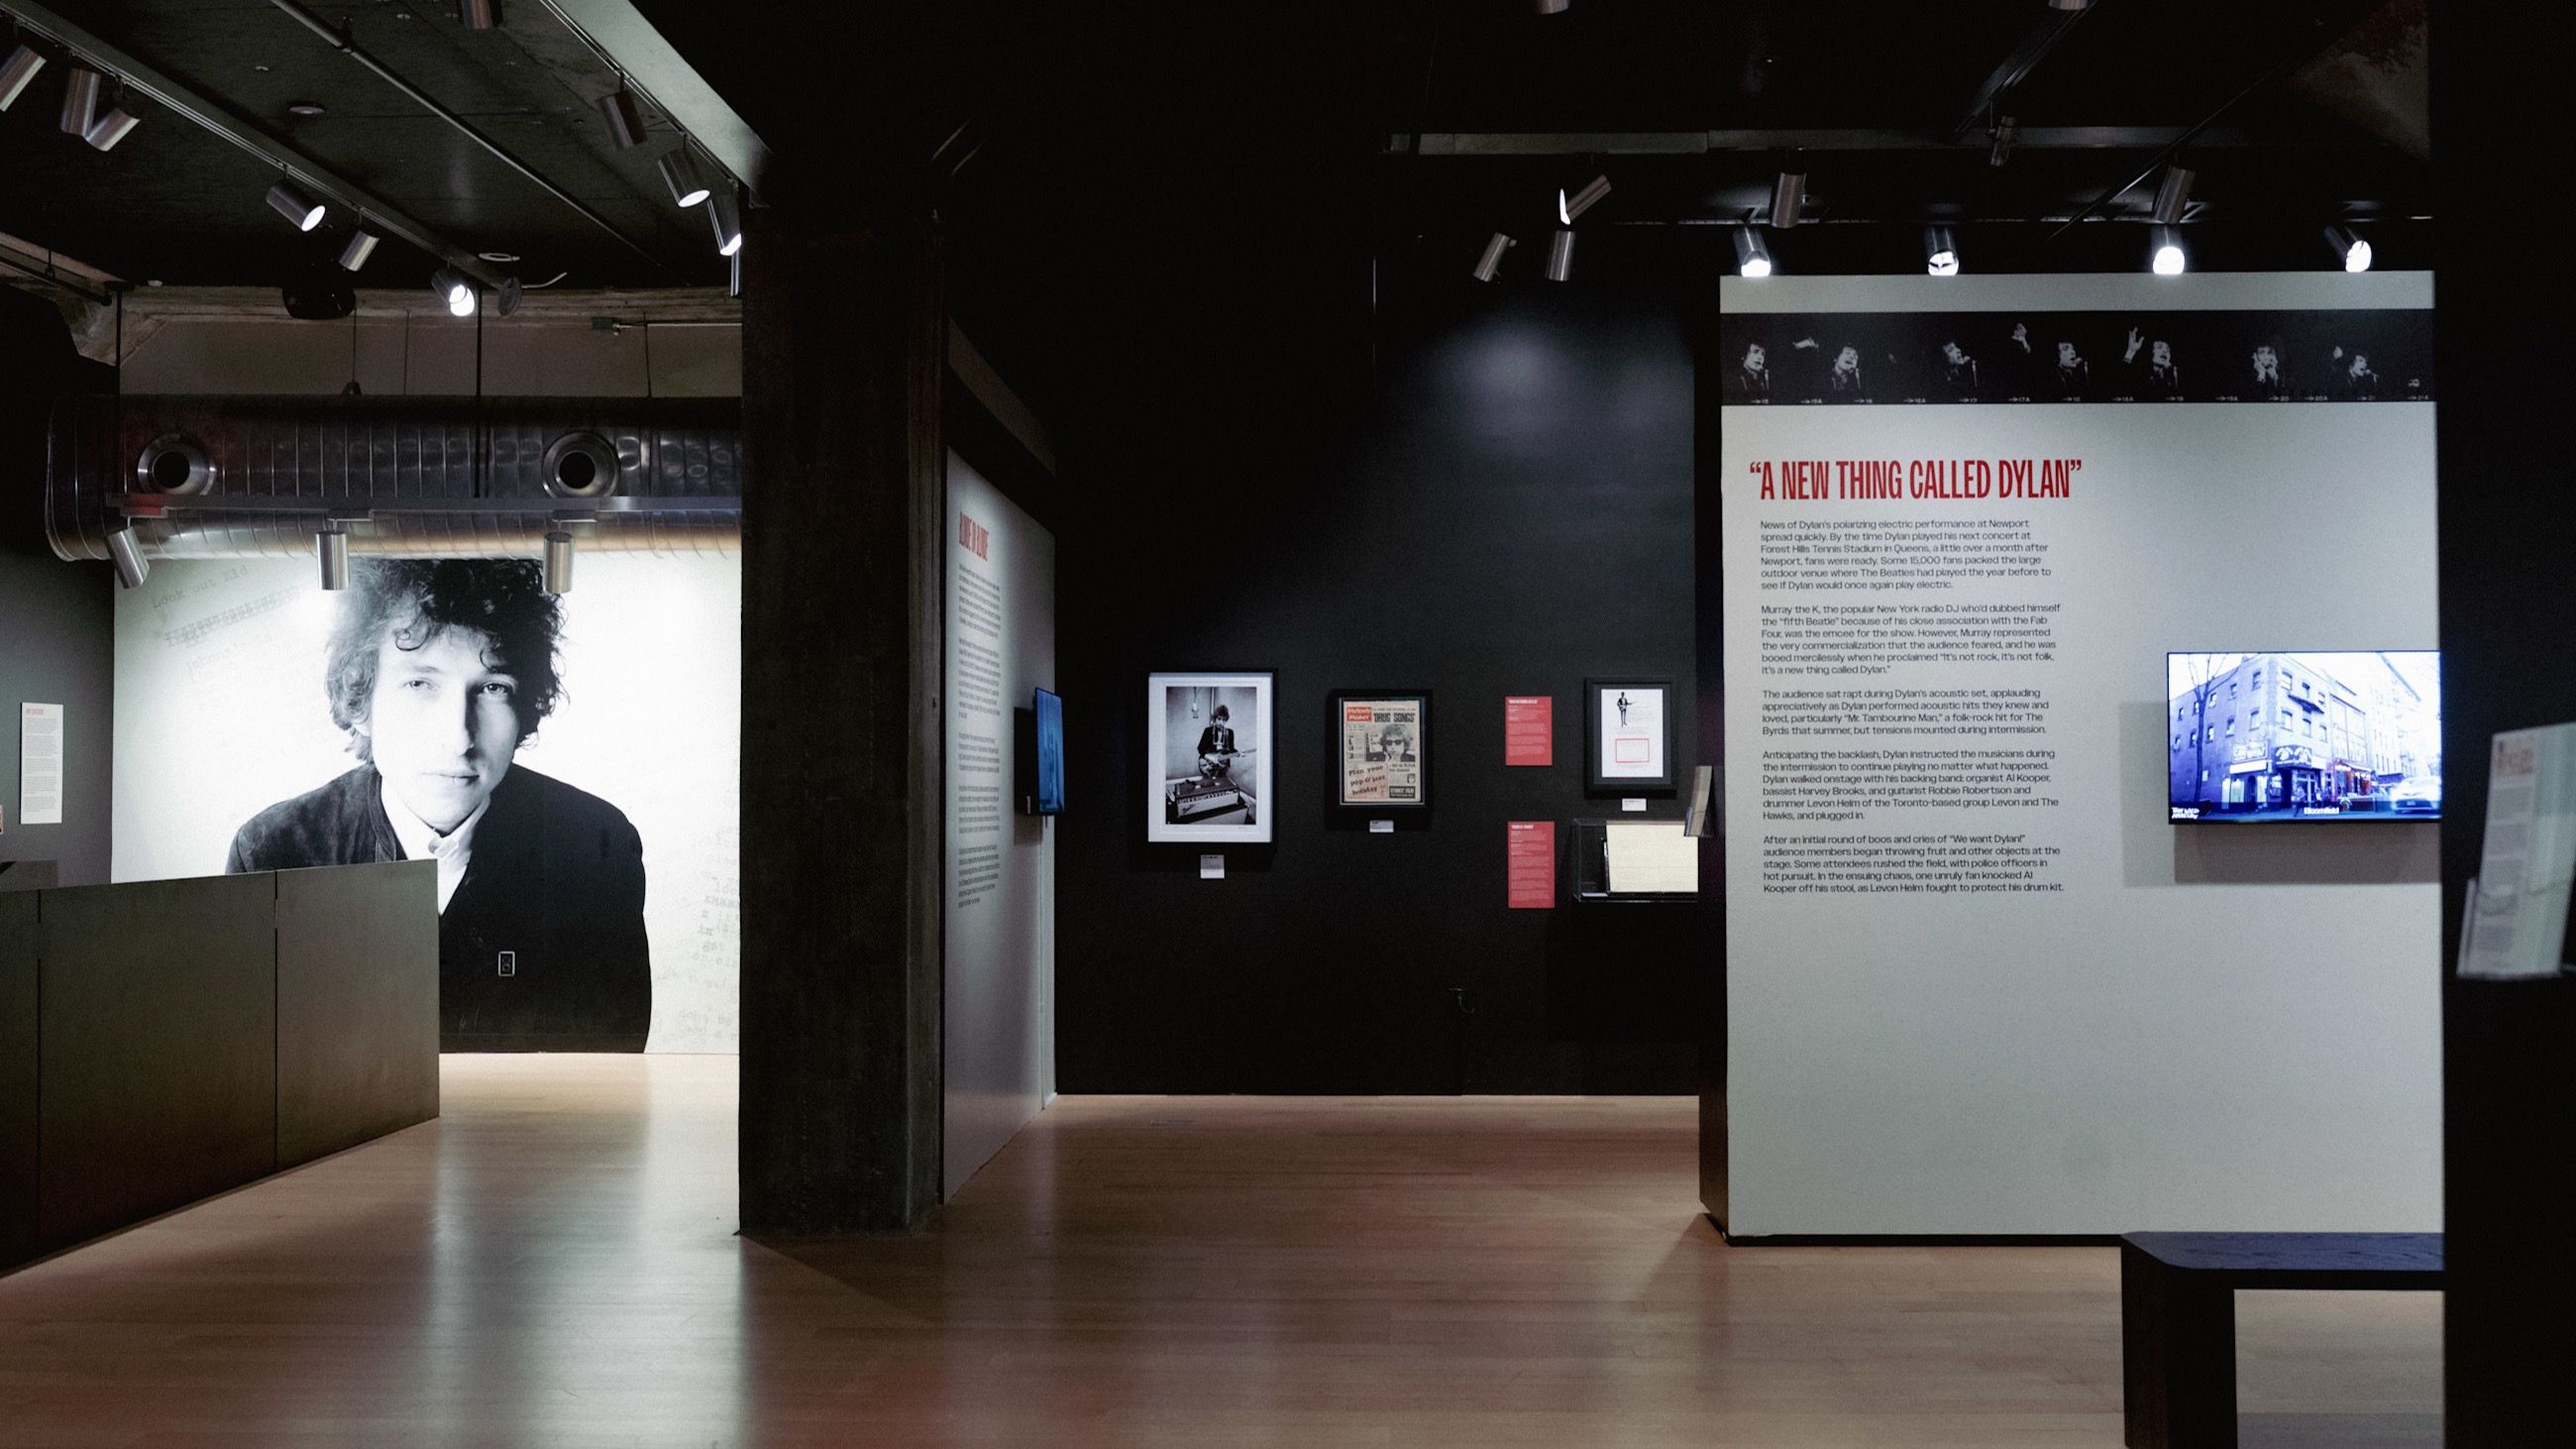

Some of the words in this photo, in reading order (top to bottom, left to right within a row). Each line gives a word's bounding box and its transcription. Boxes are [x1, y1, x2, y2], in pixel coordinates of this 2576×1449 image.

[1750, 461, 1775, 500] “A
[1782, 461, 1829, 500] NEW
[1836, 460, 1902, 500] THING
[1909, 460, 1991, 500] CALLED
[1998, 459, 2083, 499] DYLAN”
[1761, 531, 1793, 542] spread
[1829, 531, 1842, 542] By
[1844, 531, 1861, 540] the
[1862, 531, 1883, 540] time
[1884, 531, 1911, 542] Dylan
[1911, 531, 1943, 542] played
[1944, 531, 1958, 540] his
[1959, 530, 1981, 540] next
[1982, 530, 2019, 540] concert
[2020, 530, 2031, 540] at
[1761, 543, 1790, 553] Forest
[1791, 543, 1810, 553] Hills
[1812, 543, 1842, 553] Tennis
[1843, 543, 1882, 552] Stadium
[1883, 543, 1892, 552] in
[1940, 543, 1962, 552] little
[1992, 543, 2024, 552] month
[2025, 542, 2048, 552] after
[1761, 568, 1798, 577] outdoor
[1830, 567, 1859, 577] where
[1860, 567, 1878, 577] The
[1879, 567, 1915, 577] Beatles
[1916, 567, 1935, 576] had
[1935, 567, 1967, 578] played
[1968, 567, 1985, 576] the
[1986, 569, 2006, 578] year
[2007, 567, 2039, 576] before
[2041, 567, 2052, 576] to
[192, 579, 217, 594] out
[1805, 627, 1821, 637] the
[1857, 627, 1871, 637] for
[1873, 627, 1888, 637] the
[1960, 627, 1992, 638] Murray
[1992, 627, 2051, 638] represented
[1762, 640, 1778, 649] the
[1779, 642, 1800, 651] very
[1801, 639, 1886, 649] commercialization
[1887, 639, 1907, 649] that
[1909, 639, 1926, 649] the
[1927, 639, 1970, 649] audience
[2004, 639, 2023, 648] and
[2023, 639, 2036, 648] he
[1762, 701, 1827, 712] appreciatively
[1841, 701, 1868, 712] Dylan
[1868, 701, 1919, 712] performed
[1920, 701, 1961, 710] acoustic
[1962, 701, 1981, 710] hits
[1982, 700, 2004, 712] they
[2004, 700, 2030, 710] knew
[2031, 700, 2050, 710] and
[1762, 725, 1789, 736] Byrds
[1791, 725, 1811, 734] that
[1853, 724, 1871, 734] but
[1872, 724, 1912, 734] tensions
[1913, 724, 1957, 734] mounted
[1957, 724, 1987, 736] during
[1763, 749, 1819, 760] Anticipating
[1820, 749, 1837, 758] the
[1882, 749, 1909, 760] Dylan
[1909, 749, 1959, 758] instructed
[1961, 749, 1977, 758] the
[1978, 748, 2024, 758] musicians
[2025, 748, 2056, 760] during
[1367, 764, 1383, 773] your
[1763, 761, 1779, 771] the
[1779, 761, 1837, 771] intermission
[1839, 761, 1850, 770] to
[1851, 761, 1891, 770] continue
[1892, 761, 1926, 772] playing
[1941, 761, 1974, 770] matter
[1976, 761, 1999, 770] what
[1351, 787, 1378, 796] holiday
[1763, 785, 1797, 795] bassist
[1798, 785, 1831, 797] Harvey
[1868, 785, 1886, 795] and
[1887, 785, 1926, 797] guitarist
[1928, 785, 1961, 794] Robbie
[1962, 785, 2012, 794] Robertson
[2013, 785, 2032, 794] and
[1763, 846, 1806, 855] audience
[1806, 846, 1852, 855] members
[1853, 846, 1883, 857] began
[1884, 846, 1926, 857] throwing
[1927, 845, 1947, 855] fruit
[1949, 845, 1967, 855] and
[1968, 845, 1993, 855] other
[1994, 845, 2031, 857] objects
[2032, 845, 2043, 855] at
[2044, 845, 2061, 855] the
[1793, 858, 1822, 867] Some
[1822, 858, 1873, 867] attendees
[1873, 858, 1906, 867] rushed
[1907, 858, 1924, 867] the
[1949, 858, 1971, 867] with
[1971, 858, 1999, 869] police
[2000, 858, 2038, 867] officers
[2039, 858, 2048, 867] in
